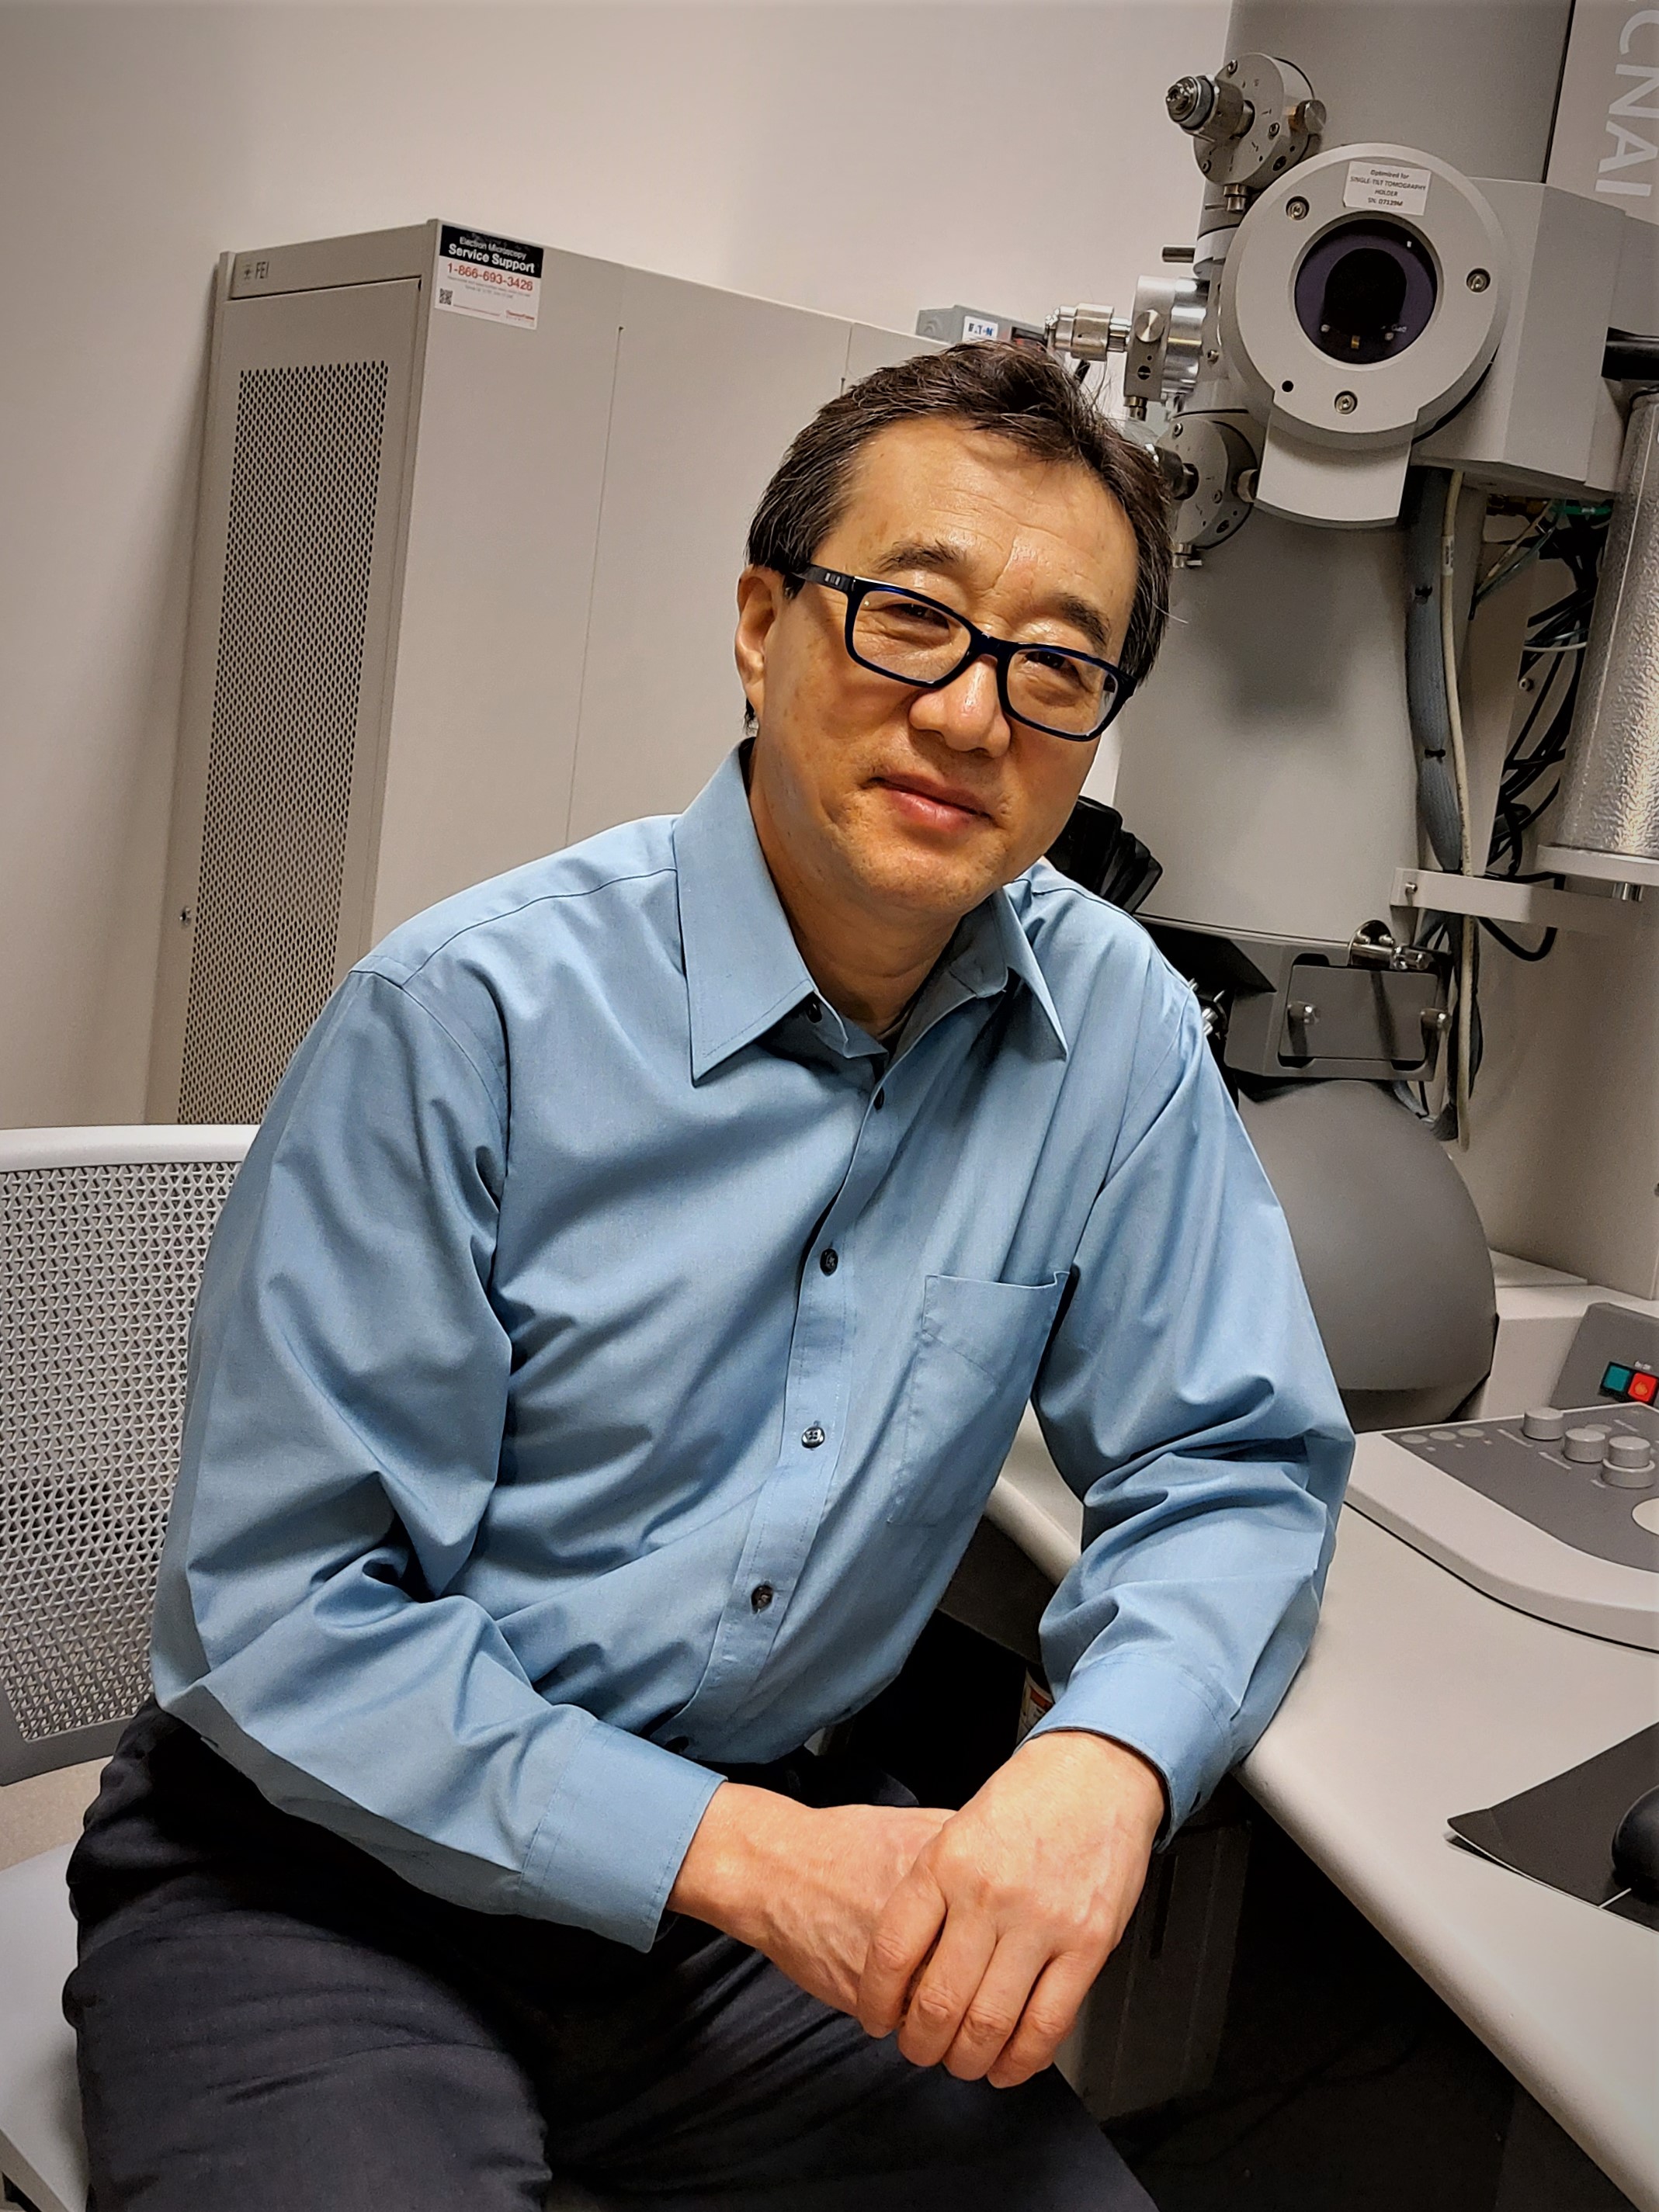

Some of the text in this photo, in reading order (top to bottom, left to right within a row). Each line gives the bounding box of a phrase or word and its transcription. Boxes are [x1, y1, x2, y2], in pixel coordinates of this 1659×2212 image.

[1370, 169, 1400, 179] Optimized
[1374, 189, 1398, 197] HOLDER
[1385, 180, 1427, 191] TOMOGRAPHY
[460, 236, 487, 250] Electron
[488, 243, 527, 261] Microscopy
[448, 243, 536, 273] Service Support
[255, 261, 269, 279] FEI
[447, 262, 533, 291] 1-866-693-3426
